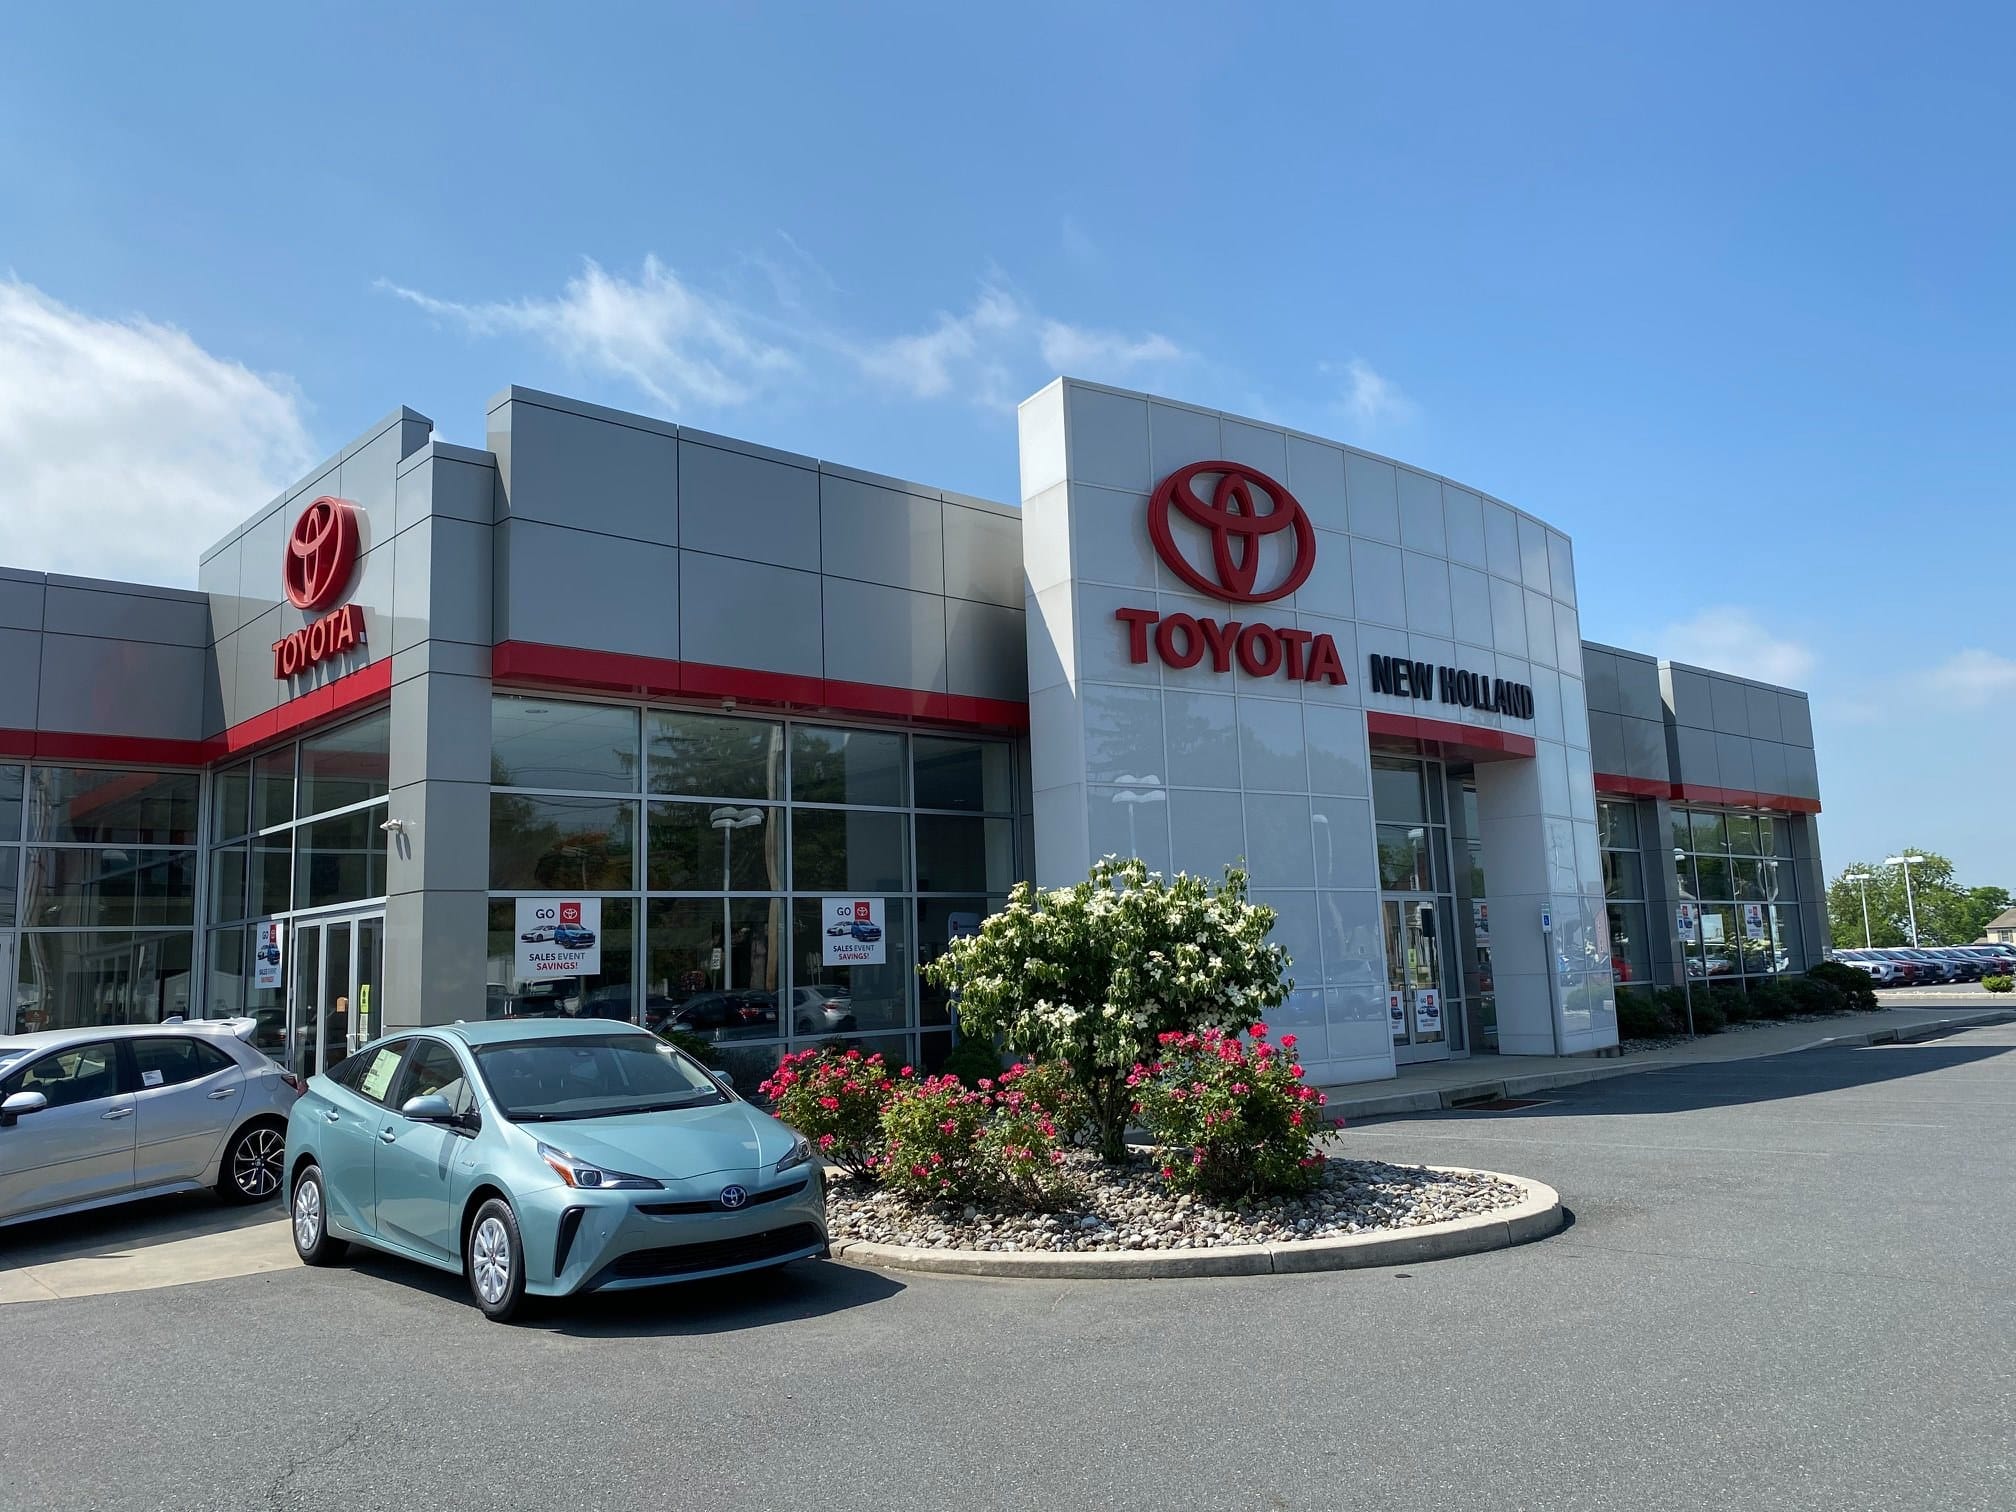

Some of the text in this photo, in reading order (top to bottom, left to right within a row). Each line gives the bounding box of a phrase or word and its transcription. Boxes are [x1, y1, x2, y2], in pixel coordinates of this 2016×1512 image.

[272, 604, 368, 680] TOYOTA
[1115, 607, 1348, 686] TOYOTA
[1370, 653, 1535, 721] NEW HOLLAND
[536, 909, 555, 919] GO
[837, 907, 851, 916] GO
[854, 944, 874, 952] EVENT
[529, 952, 585, 961] SALES EVENT
[536, 962, 578, 971] SAVINGS!
